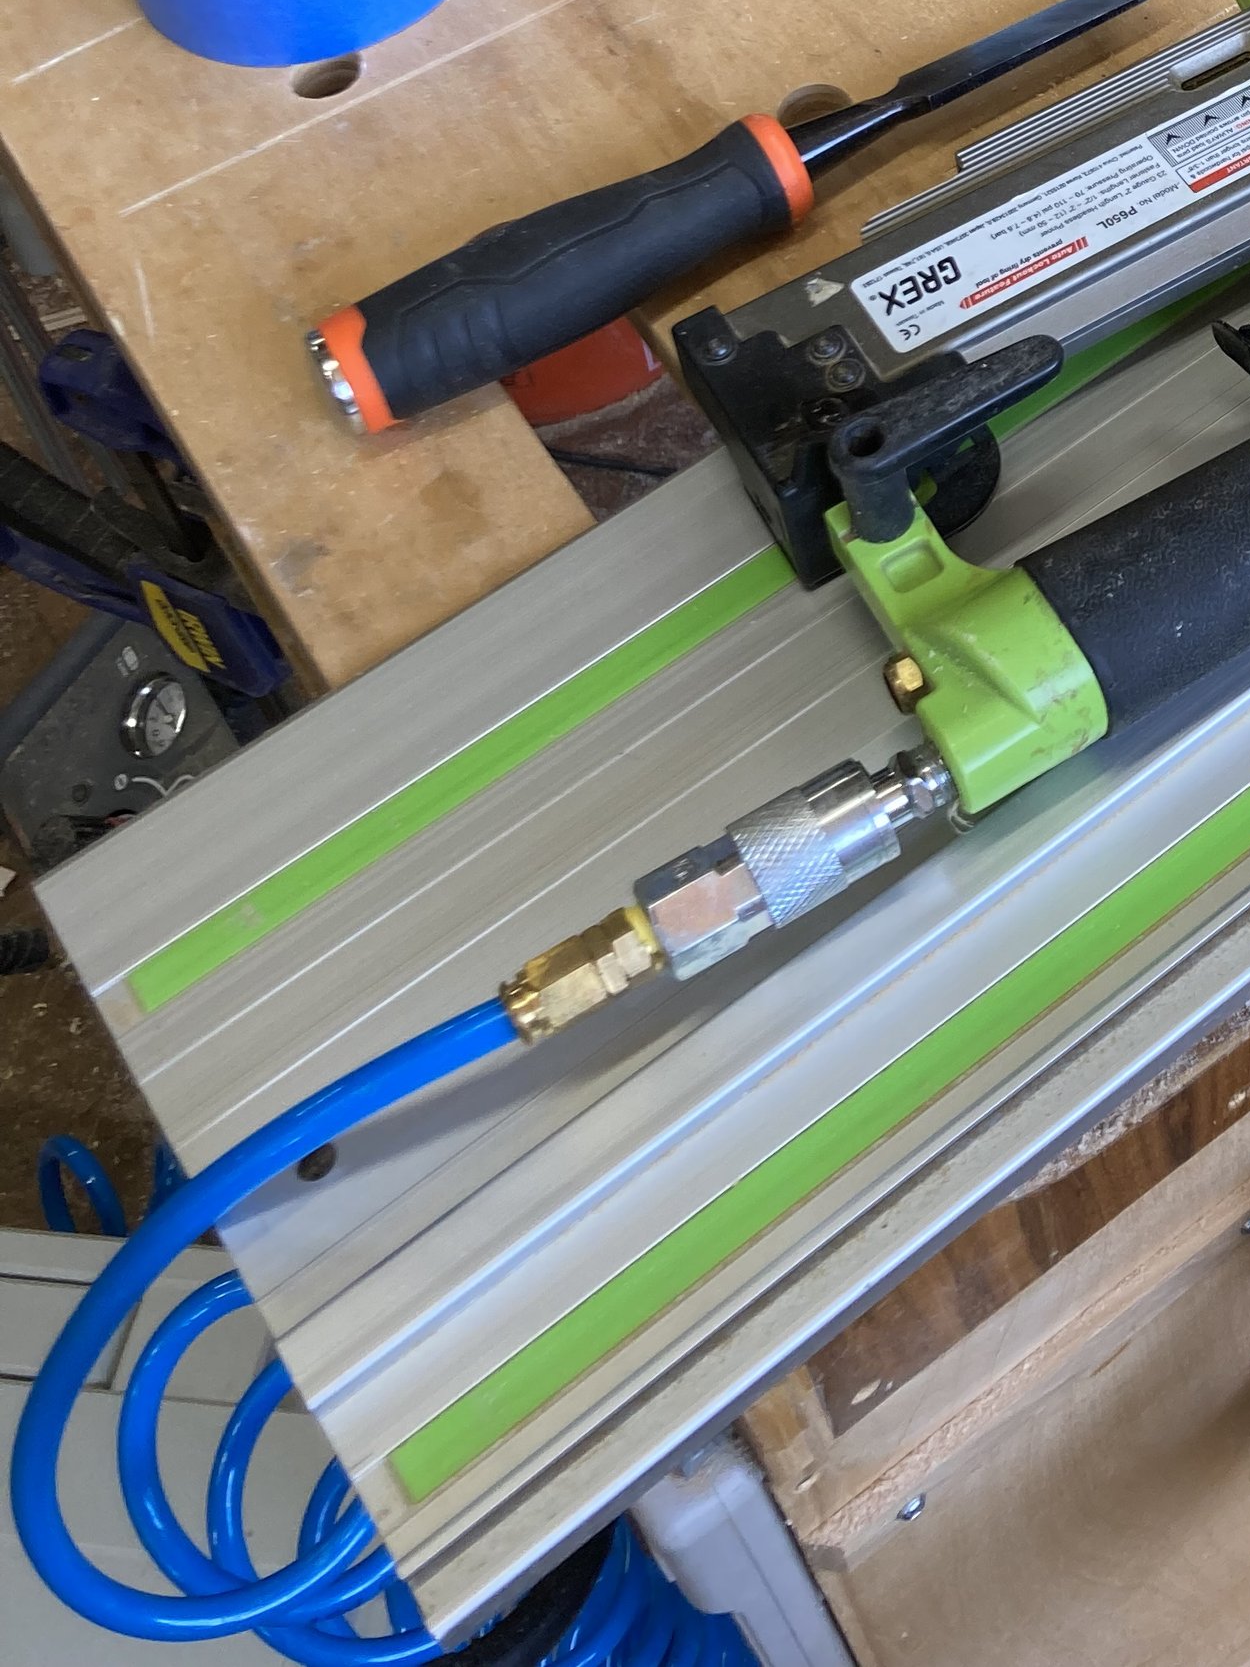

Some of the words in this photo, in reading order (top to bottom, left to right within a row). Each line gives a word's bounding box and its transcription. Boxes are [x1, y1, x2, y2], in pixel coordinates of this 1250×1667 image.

[1239, 109, 1250, 118] pin
[1218, 115, 1241, 129] arrows
[1194, 126, 1219, 141] pointed
[1205, 127, 1234, 144] ALWAYS
[1175, 148, 1191, 159] pins
[1190, 141, 1206, 152] load
[1219, 141, 1241, 155] longer
[1204, 152, 1220, 163] than
[1230, 150, 1241, 158] for
[1117, 153, 1154, 175] Operating
[1195, 155, 1231, 176] hardwoods
[1128, 162, 1161, 181] Fastener
[1155, 169, 1167, 178] 23
[1130, 173, 1157, 190] Gauge
[1073, 189, 1085, 198] 70
[1151, 182, 1179, 200] Model
[1052, 197, 1067, 208] 110
[1096, 190, 1124, 208] Length
[1135, 196, 1153, 208] No.
[1039, 203, 1054, 214] psi
[1052, 208, 1067, 219] (12
[1063, 204, 1098, 225] Headless
[1036, 219, 1047, 228] 50
[1095, 204, 1138, 232] P650L
[989, 227, 1007, 240] bar)
[1017, 223, 1037, 237] mm)
[1039, 222, 1064, 238] Pinner
[1031, 238, 1064, 258] prevents
[1049, 245, 1074, 261] Auto
[1017, 254, 1032, 265] dry
[997, 261, 1020, 276] firing
[1010, 257, 1051, 282] Lockout
[974, 277, 990, 288] tool
[988, 272, 1000, 281] of
[872, 254, 966, 316] GREX
[972, 277, 1011, 301] Feature
